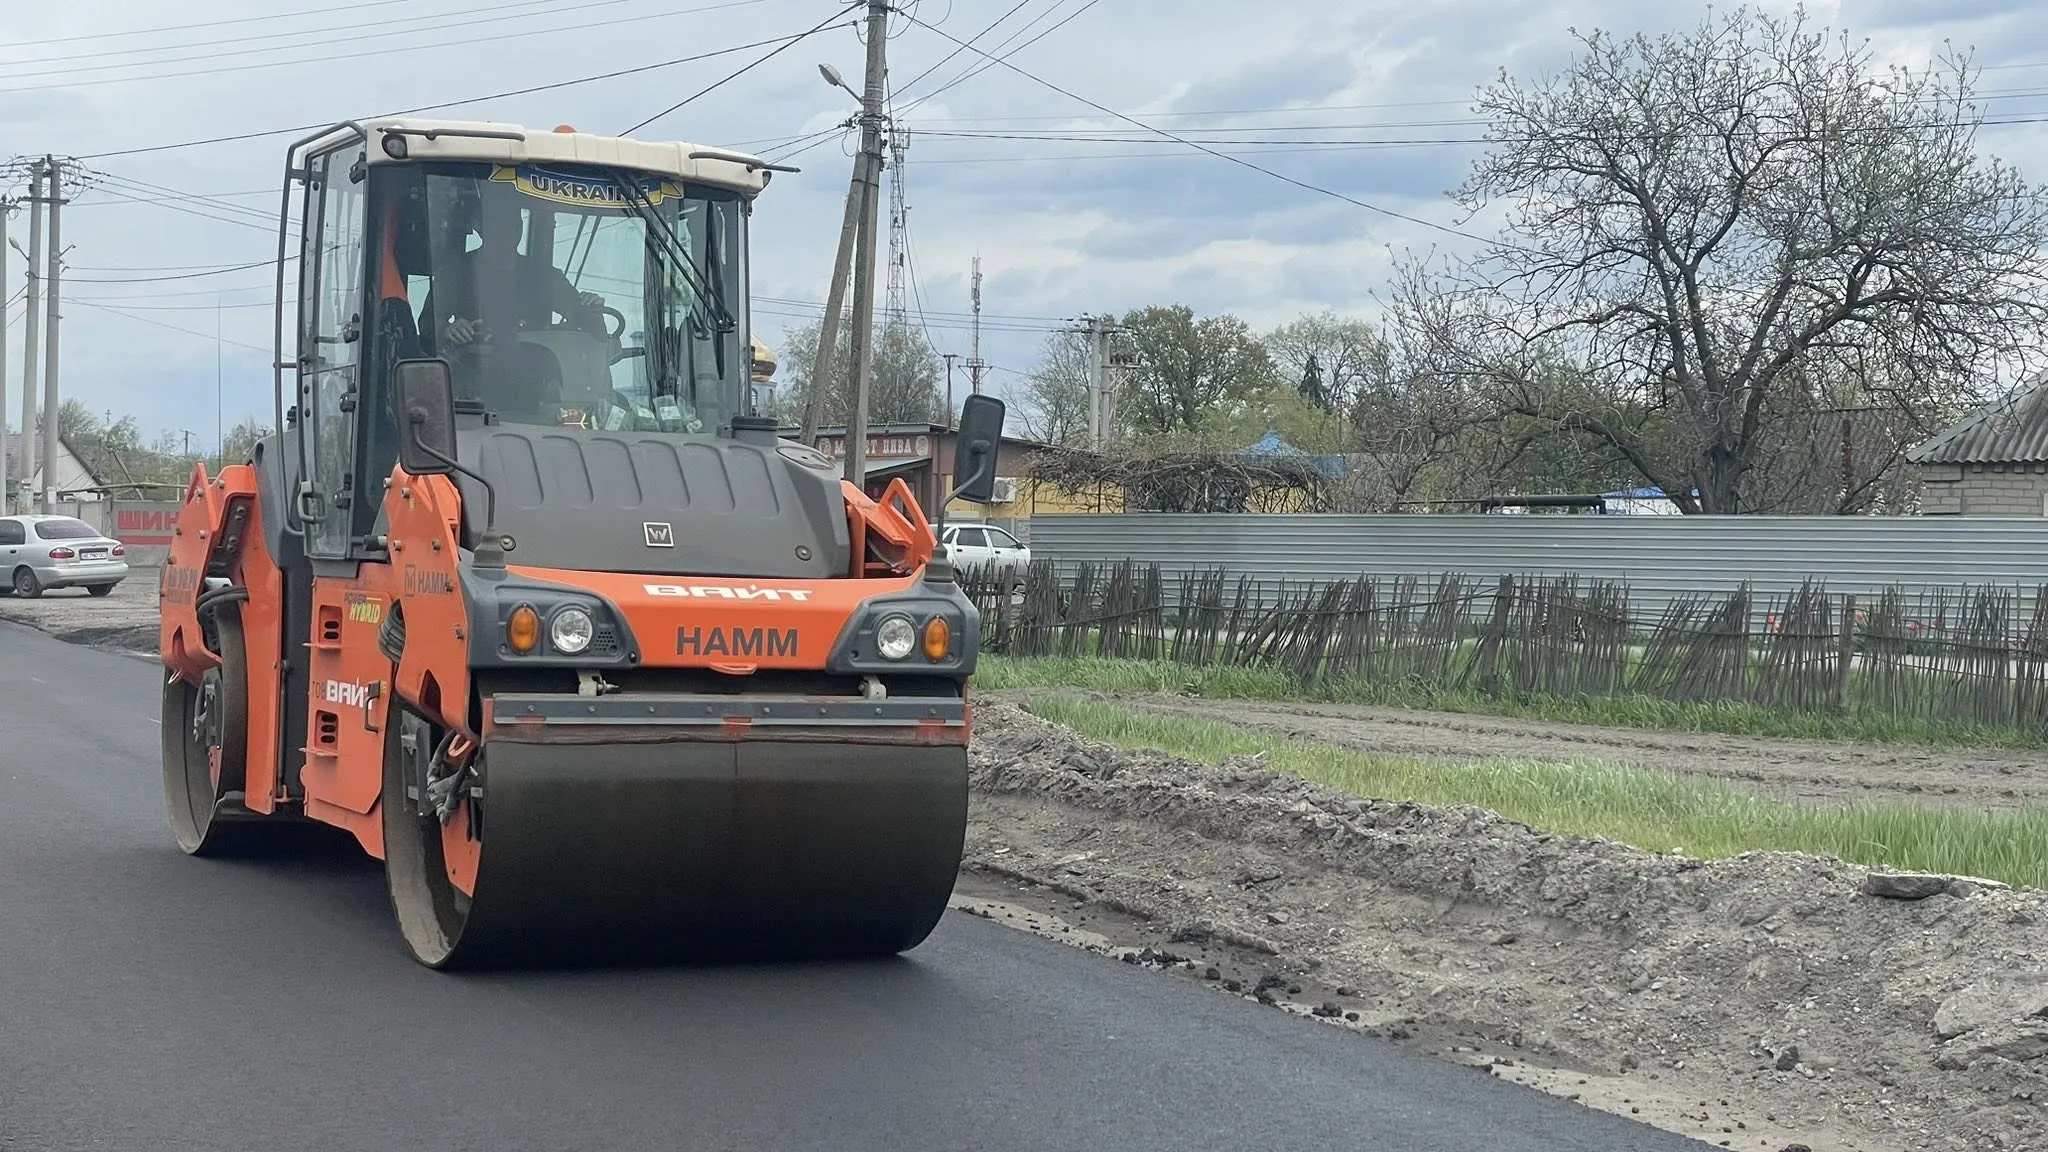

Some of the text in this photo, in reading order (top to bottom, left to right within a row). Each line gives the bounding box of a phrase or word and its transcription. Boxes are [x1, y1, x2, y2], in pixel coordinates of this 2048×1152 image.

[882, 438, 912, 454] ПИВА
[418, 570, 450, 596] HAMM
[643, 584, 812, 601] ВАЙТ
[349, 602, 381, 624] HYBRID
[676, 626, 798, 657] HAMM
